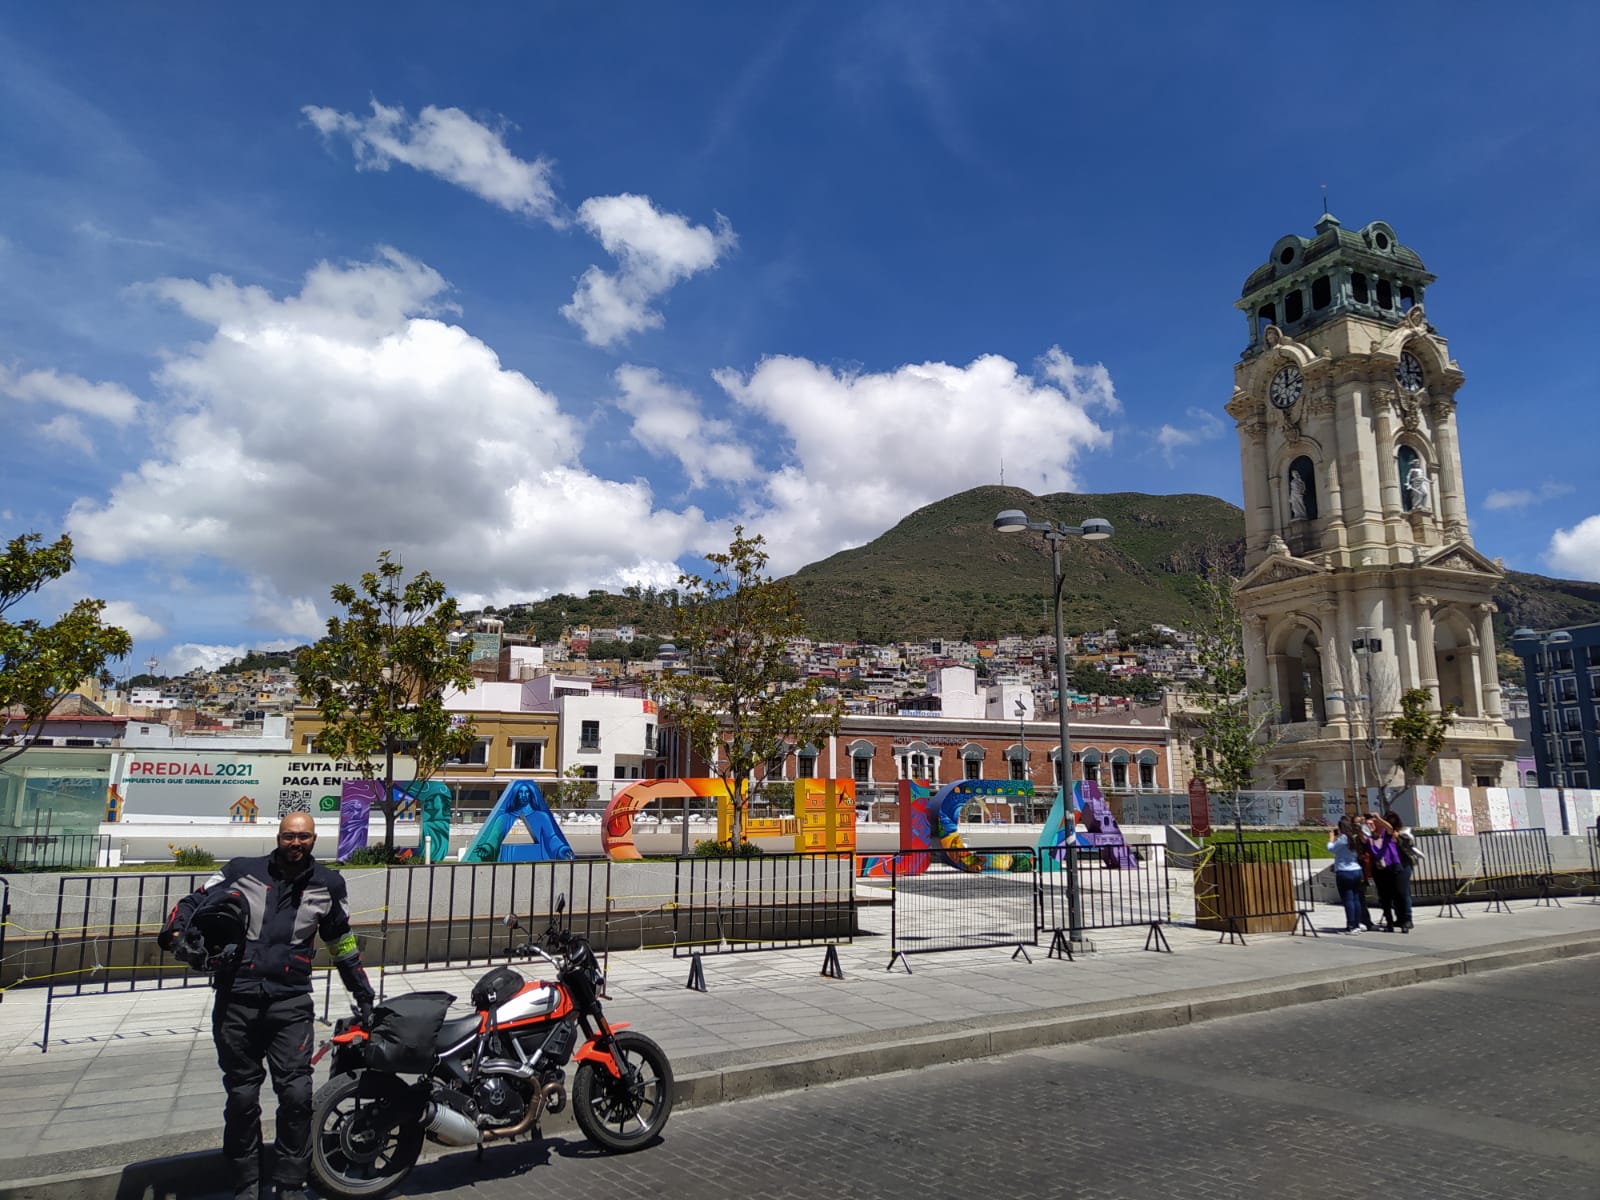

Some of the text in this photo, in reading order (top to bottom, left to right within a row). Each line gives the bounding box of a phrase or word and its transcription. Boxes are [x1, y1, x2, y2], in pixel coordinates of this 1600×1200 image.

[130, 762, 253, 776] PREDIAL 2021
[288, 762, 331, 771] ¡EVITA
[282, 776, 320, 786] PAGA
[323, 777, 341, 786] EN
